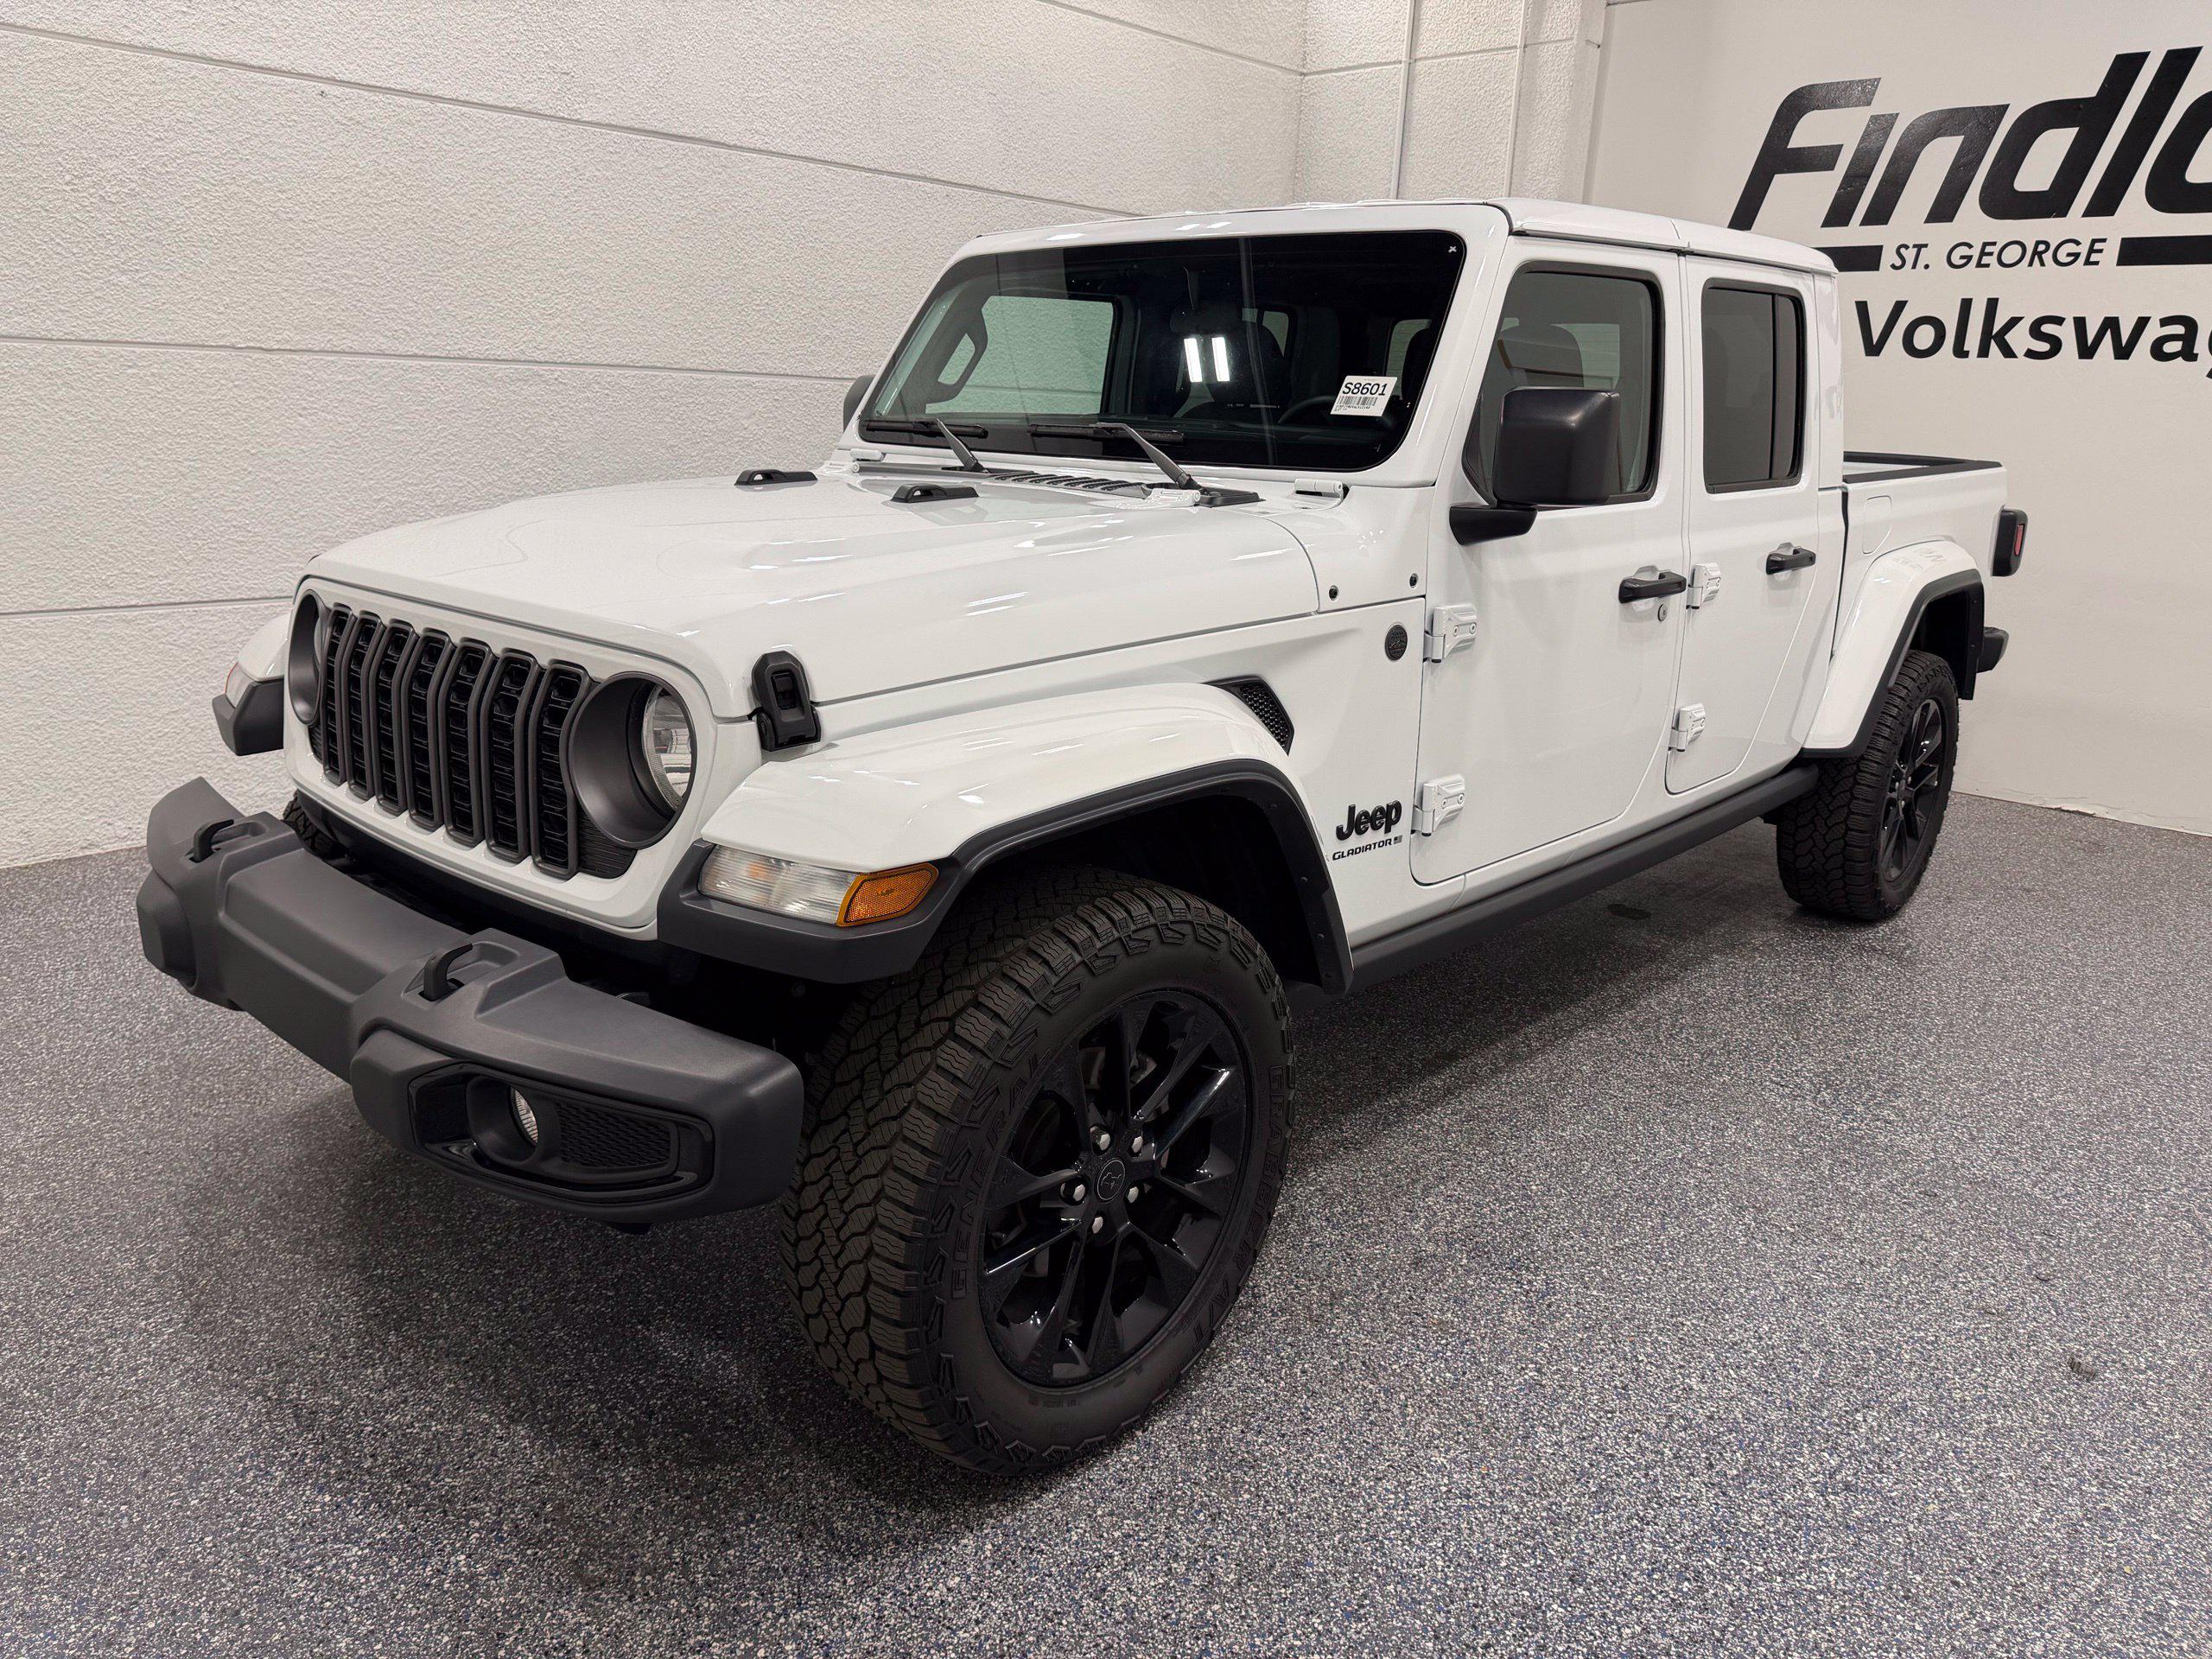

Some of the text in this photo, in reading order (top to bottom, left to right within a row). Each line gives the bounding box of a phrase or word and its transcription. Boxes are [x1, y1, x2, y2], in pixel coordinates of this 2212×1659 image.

[1889, 237, 2109, 270] ST. GEORGE
[1853, 297, 2212, 380] Volkswa
[1342, 382, 1388, 397] S8601
[1336, 800, 1402, 842] Jeep
[1332, 838, 1393, 861] GLADIATOR
